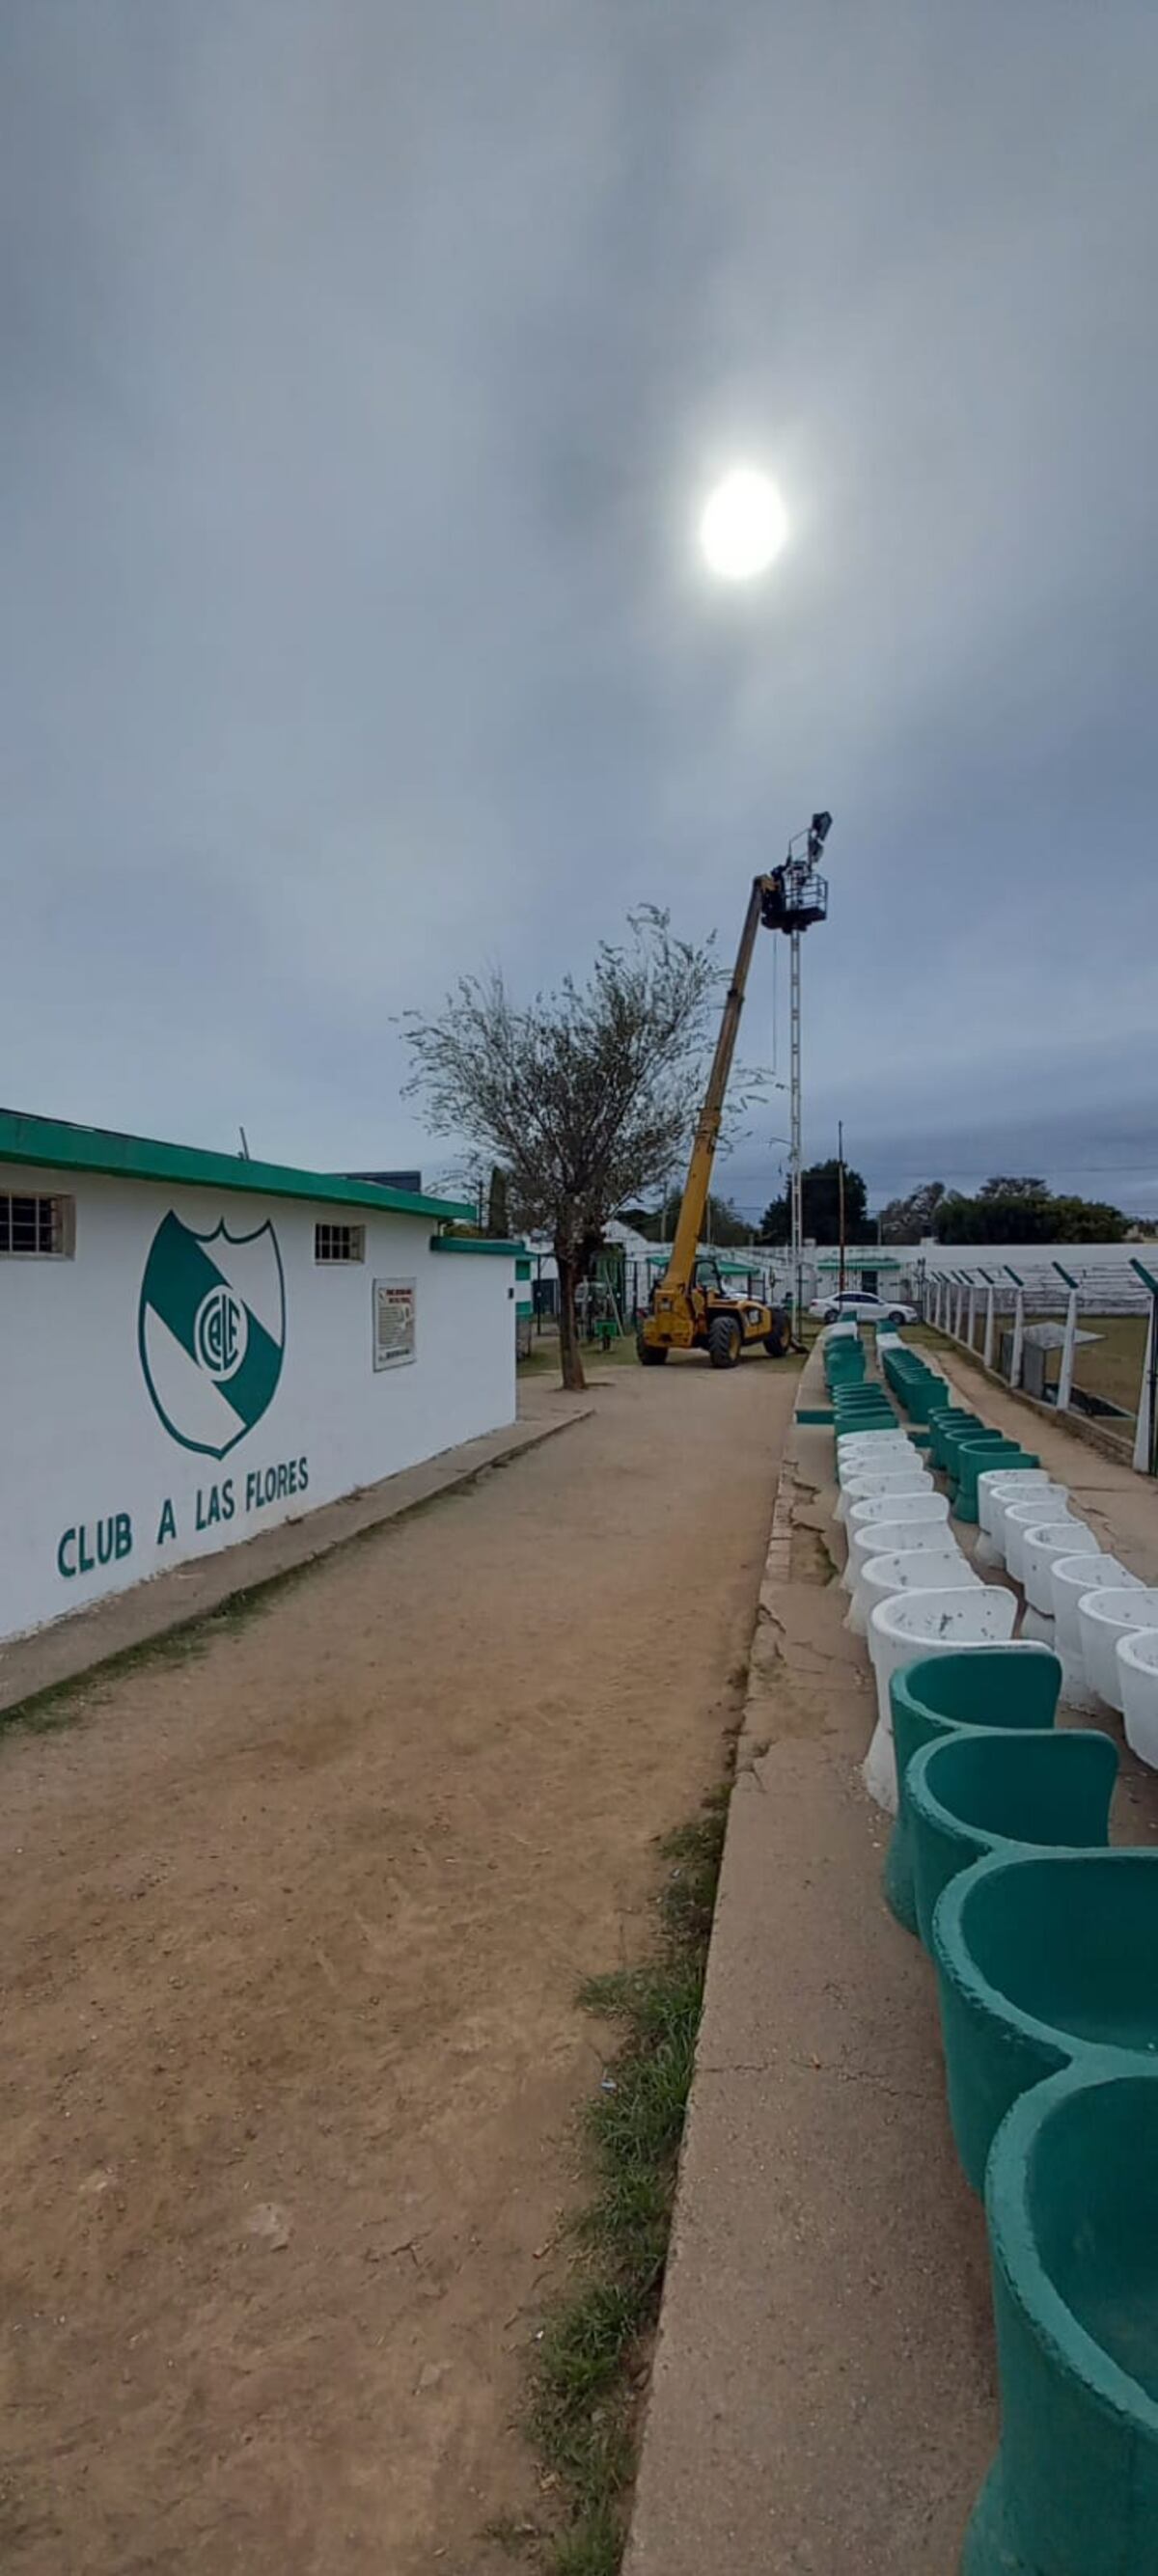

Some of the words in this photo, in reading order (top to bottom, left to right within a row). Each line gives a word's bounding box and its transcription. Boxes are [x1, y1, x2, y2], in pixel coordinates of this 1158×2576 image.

[57, 1512, 132, 1577] CLUB
[156, 1498, 177, 1546] A
[196, 1478, 234, 1530] LAS
[246, 1456, 309, 1512] FLORES
